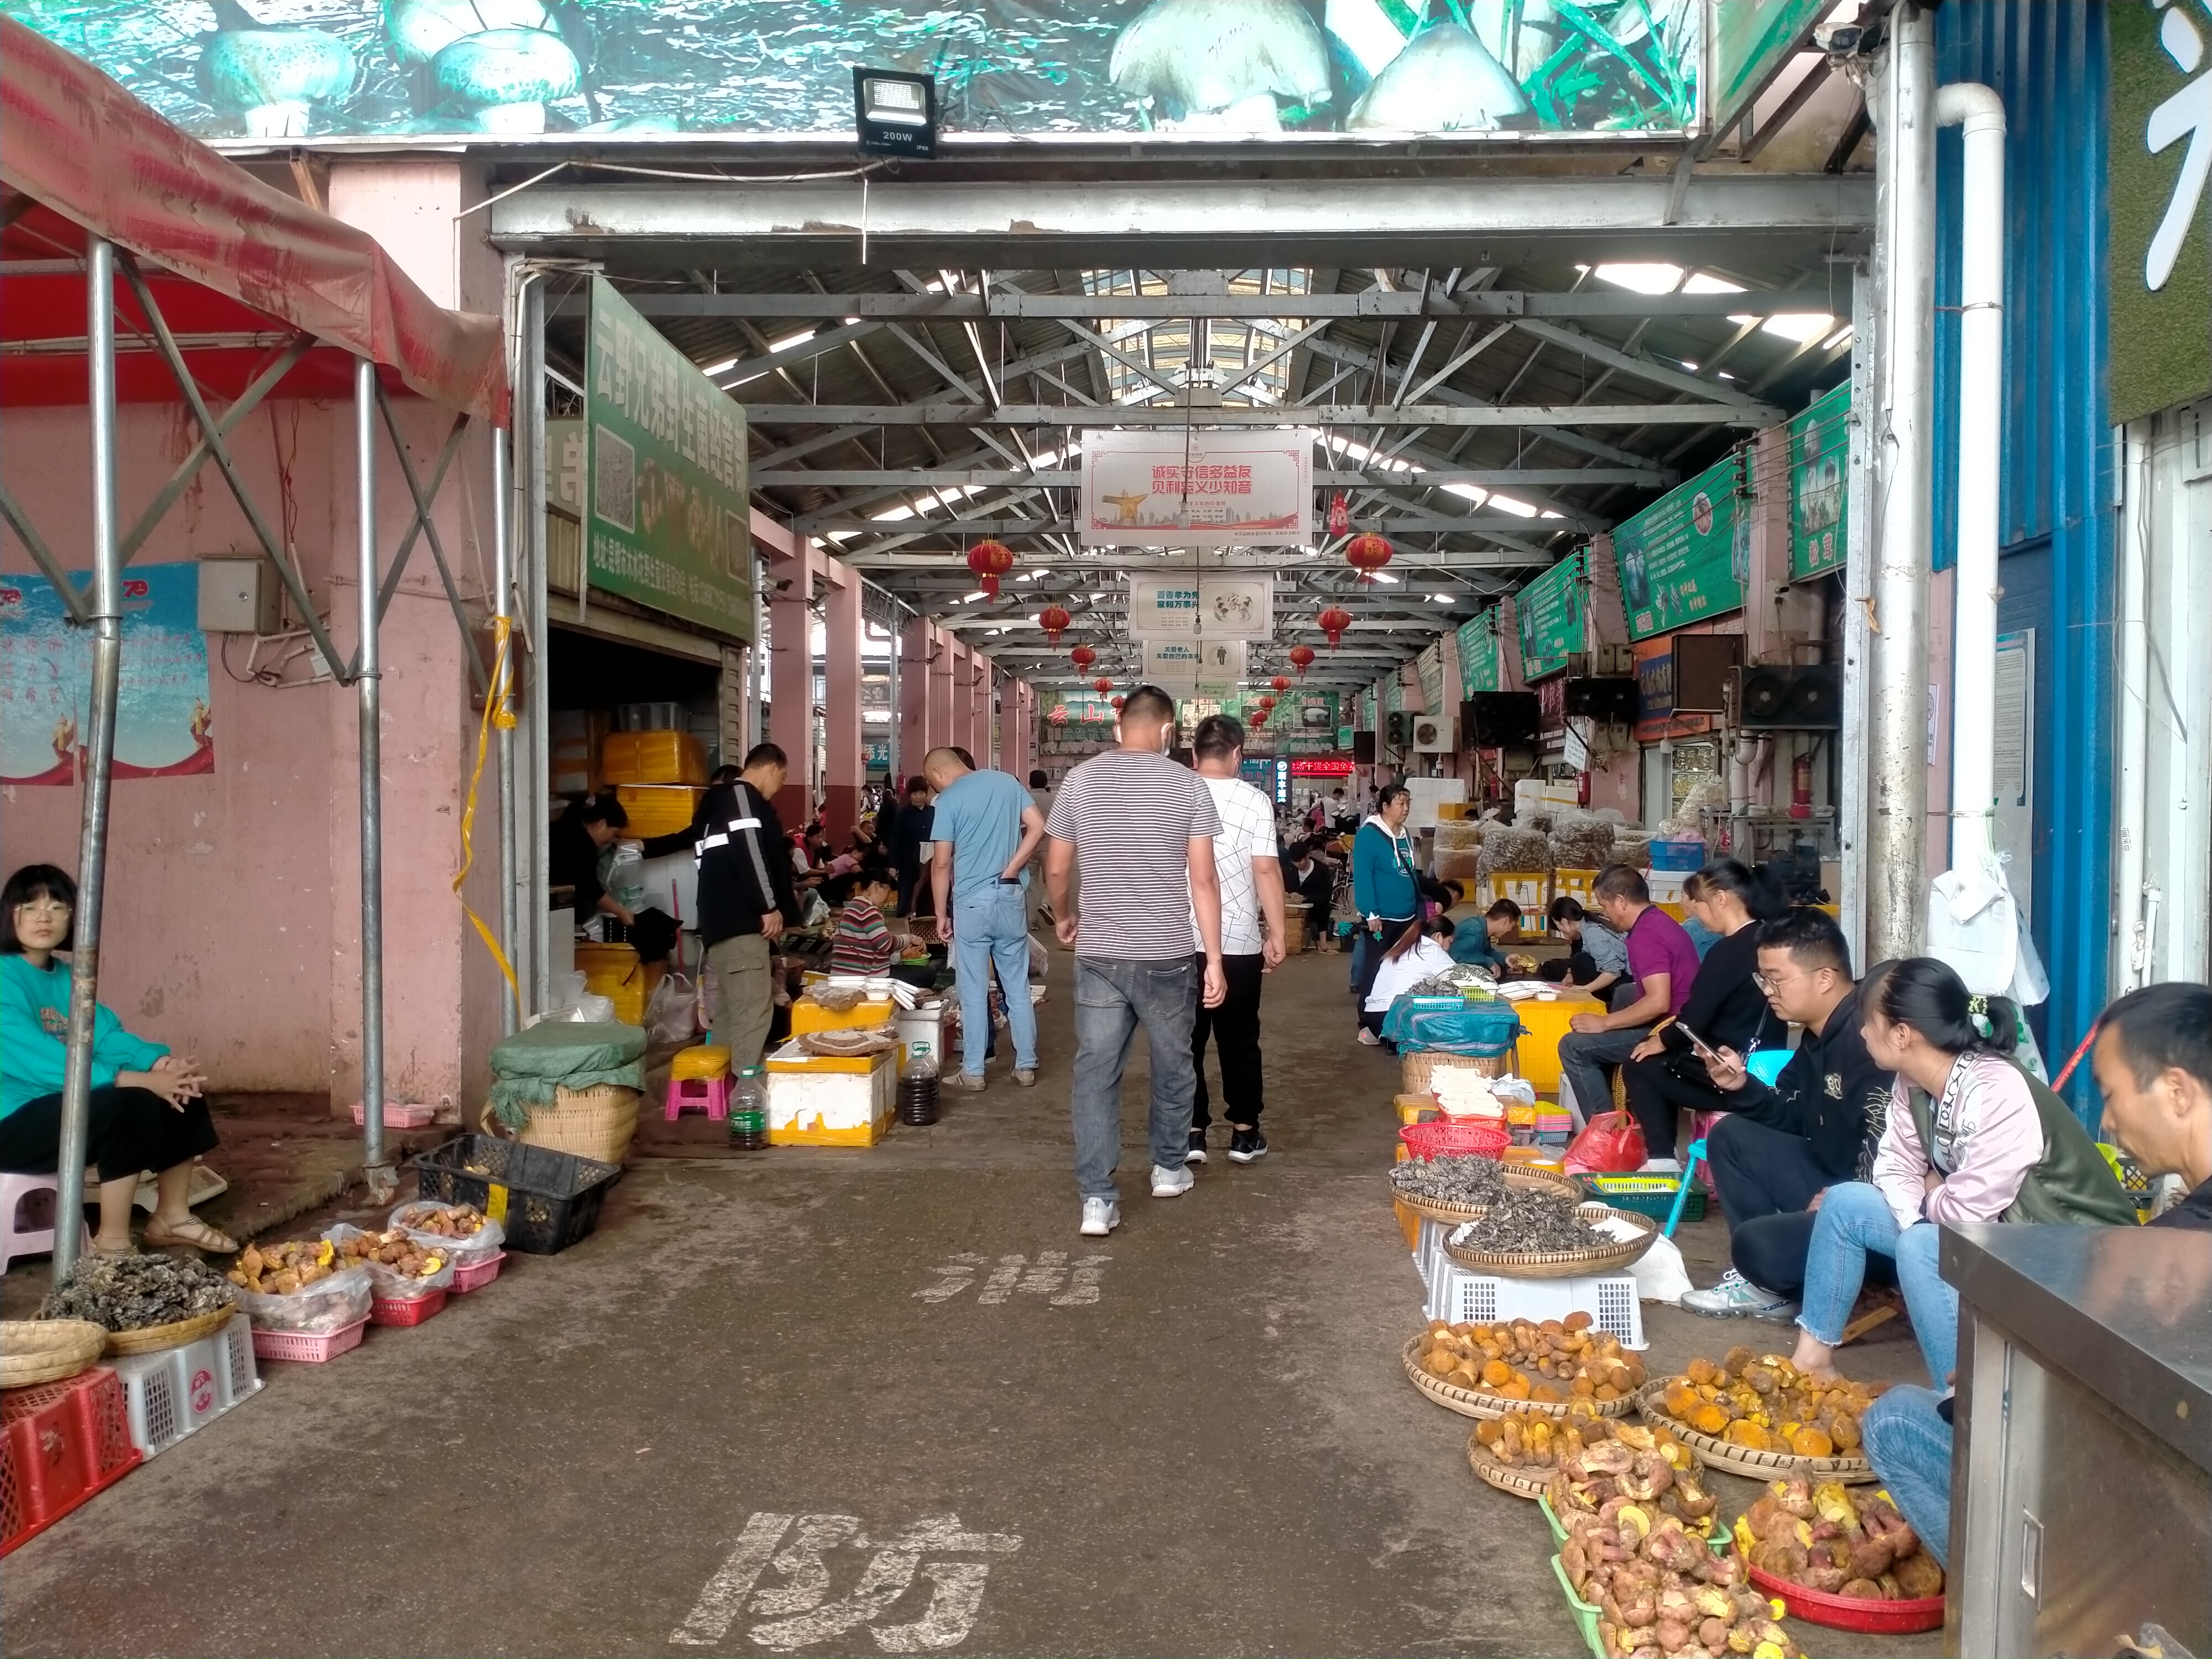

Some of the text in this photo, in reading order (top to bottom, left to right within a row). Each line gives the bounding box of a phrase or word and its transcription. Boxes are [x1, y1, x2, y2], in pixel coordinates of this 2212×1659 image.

[883, 131, 912, 142] 200W
[597, 308, 747, 499] 云野兄弟野生菌经营部
[1152, 465, 1252, 479] 诚实守信多益友
[1152, 481, 1251, 494] 见利忘义少知音
[1809, 531, 1834, 568] 松茸
[122, 580, 149, 598] 70
[1157, 591, 1199, 599] 百善孝为先
[1157, 601, 1199, 609] 家和万事兴
[865, 743, 900, 761] 添光
[669, 1512, 1024, 1653] 防
